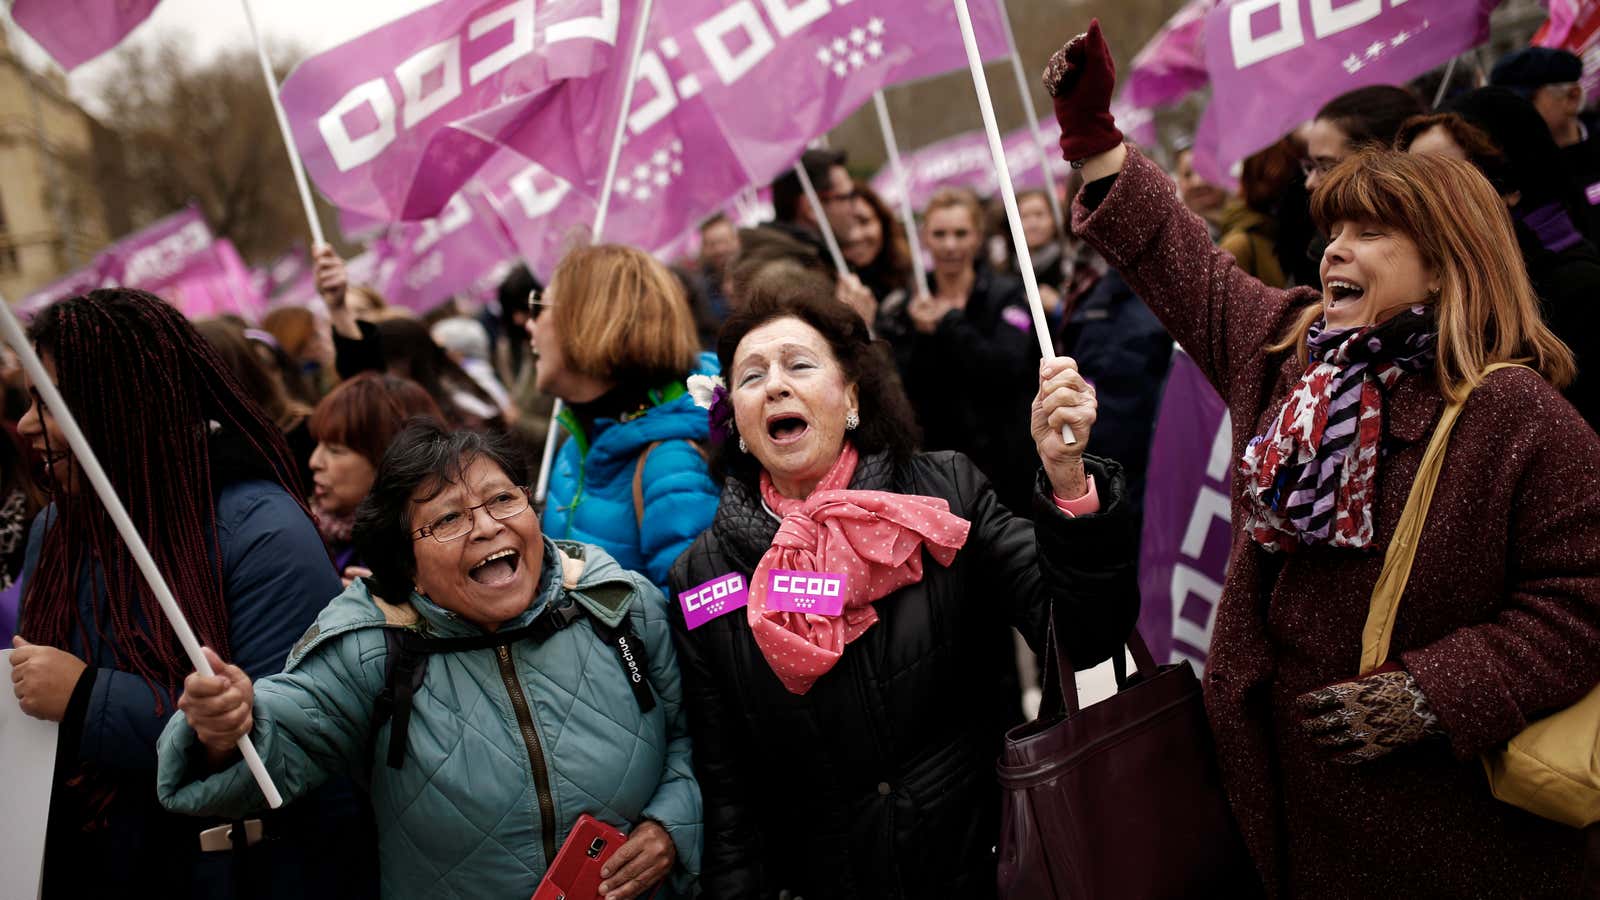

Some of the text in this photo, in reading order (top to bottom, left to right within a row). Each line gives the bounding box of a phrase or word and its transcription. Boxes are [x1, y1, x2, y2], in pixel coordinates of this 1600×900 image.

[685, 575, 743, 612] CCOO
[773, 575, 841, 597] CCOO
[618, 636, 641, 683] Quechua
